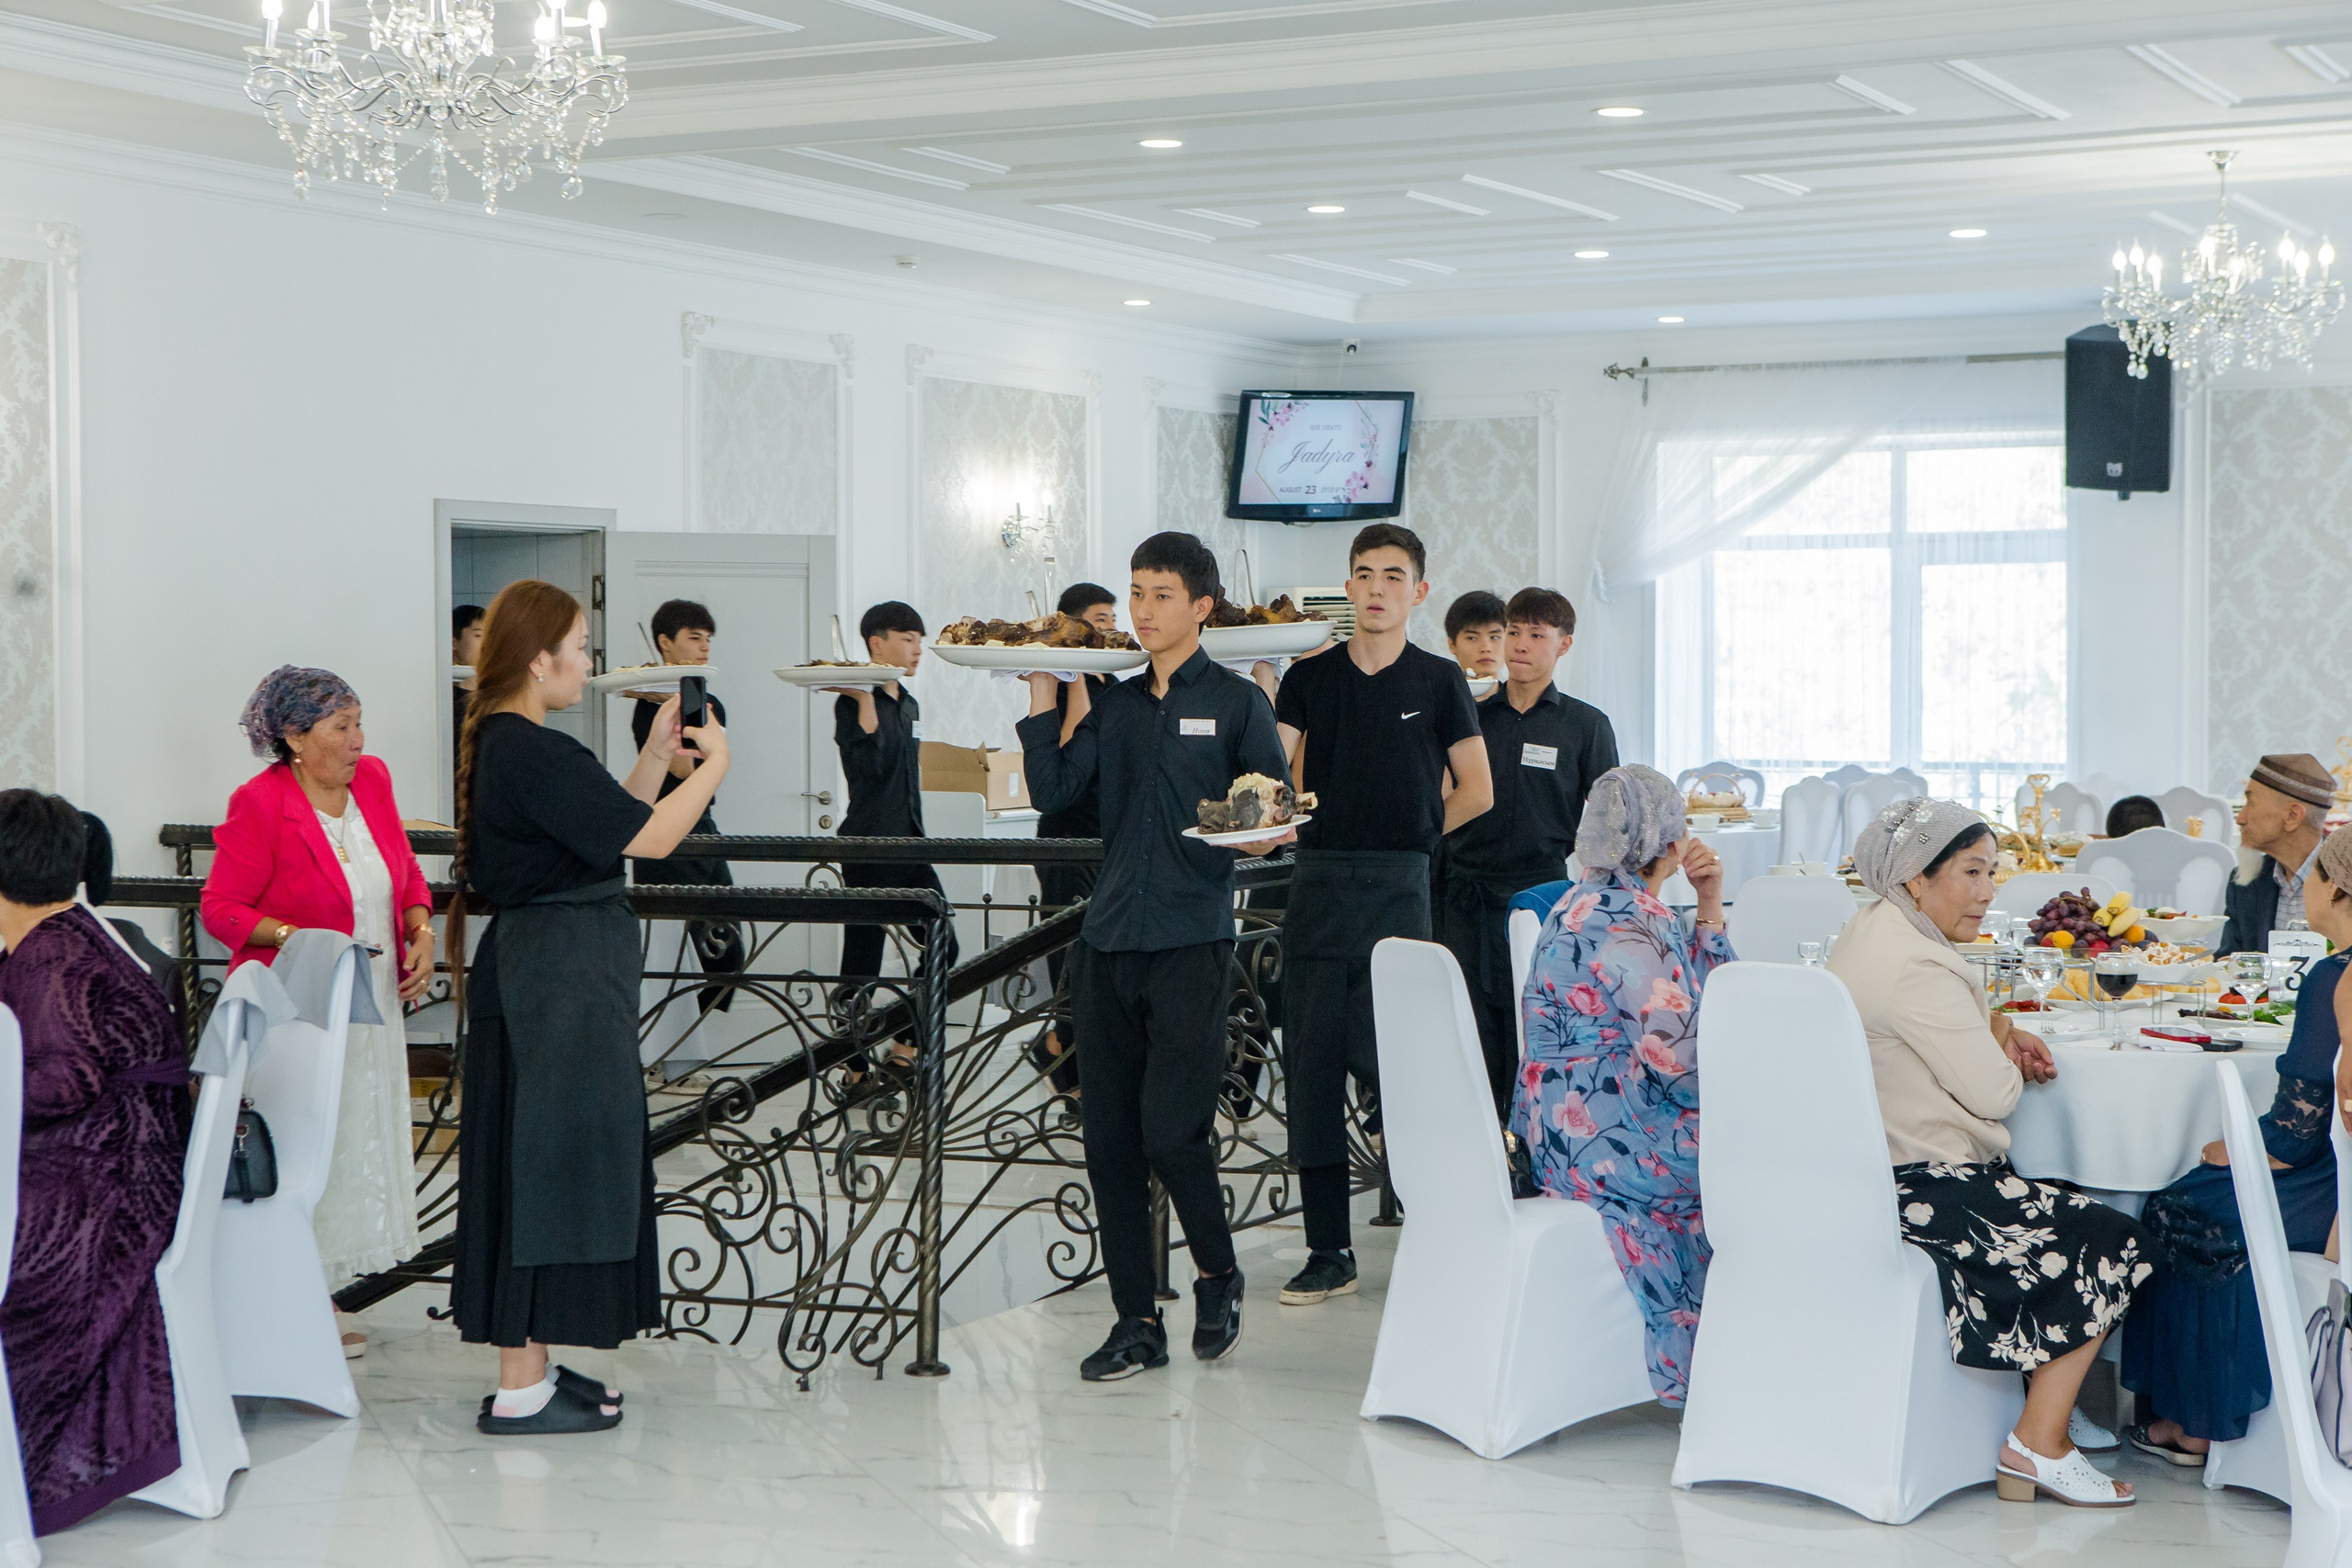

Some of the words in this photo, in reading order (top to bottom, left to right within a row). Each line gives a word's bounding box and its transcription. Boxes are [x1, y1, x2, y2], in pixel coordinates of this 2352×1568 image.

[1277, 439, 1355, 474] Jadyra
[1305, 485, 1317, 494] 23
[2285, 955, 2310, 991] 3
